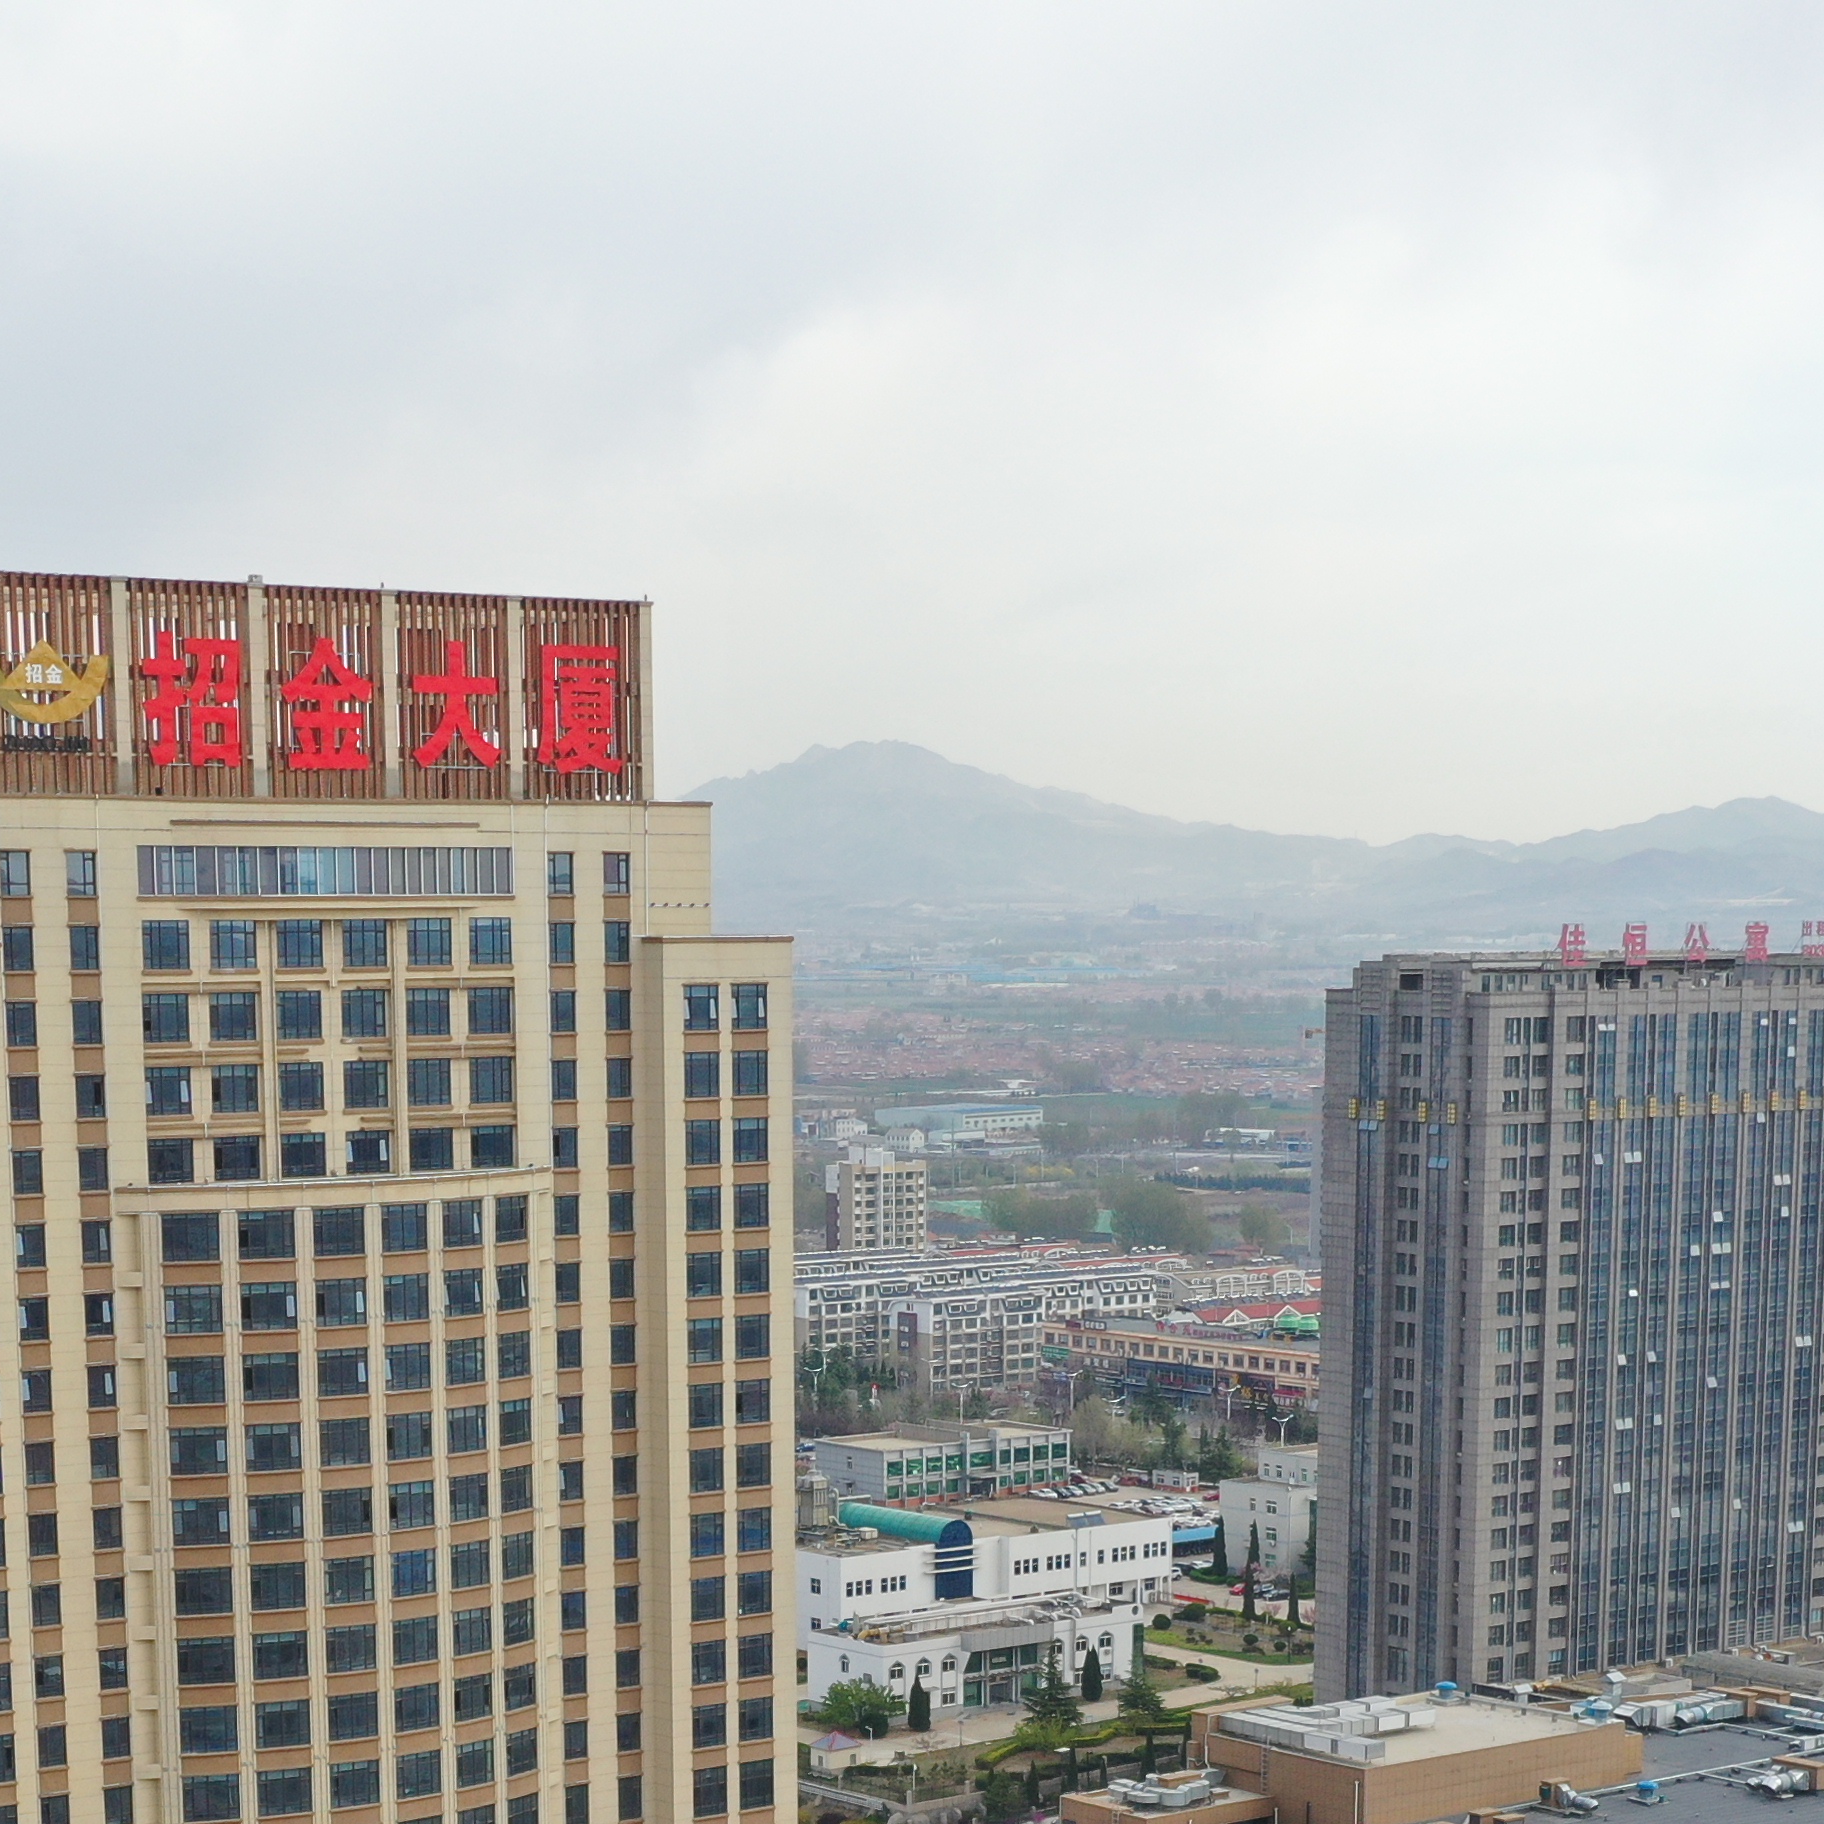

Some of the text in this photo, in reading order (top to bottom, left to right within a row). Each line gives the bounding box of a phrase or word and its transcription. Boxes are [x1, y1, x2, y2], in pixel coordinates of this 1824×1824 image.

[24, 663, 63, 685] 招金
[141, 629, 623, 774] 招金大厦
[1558, 920, 1770, 967] 佳恒公寓
